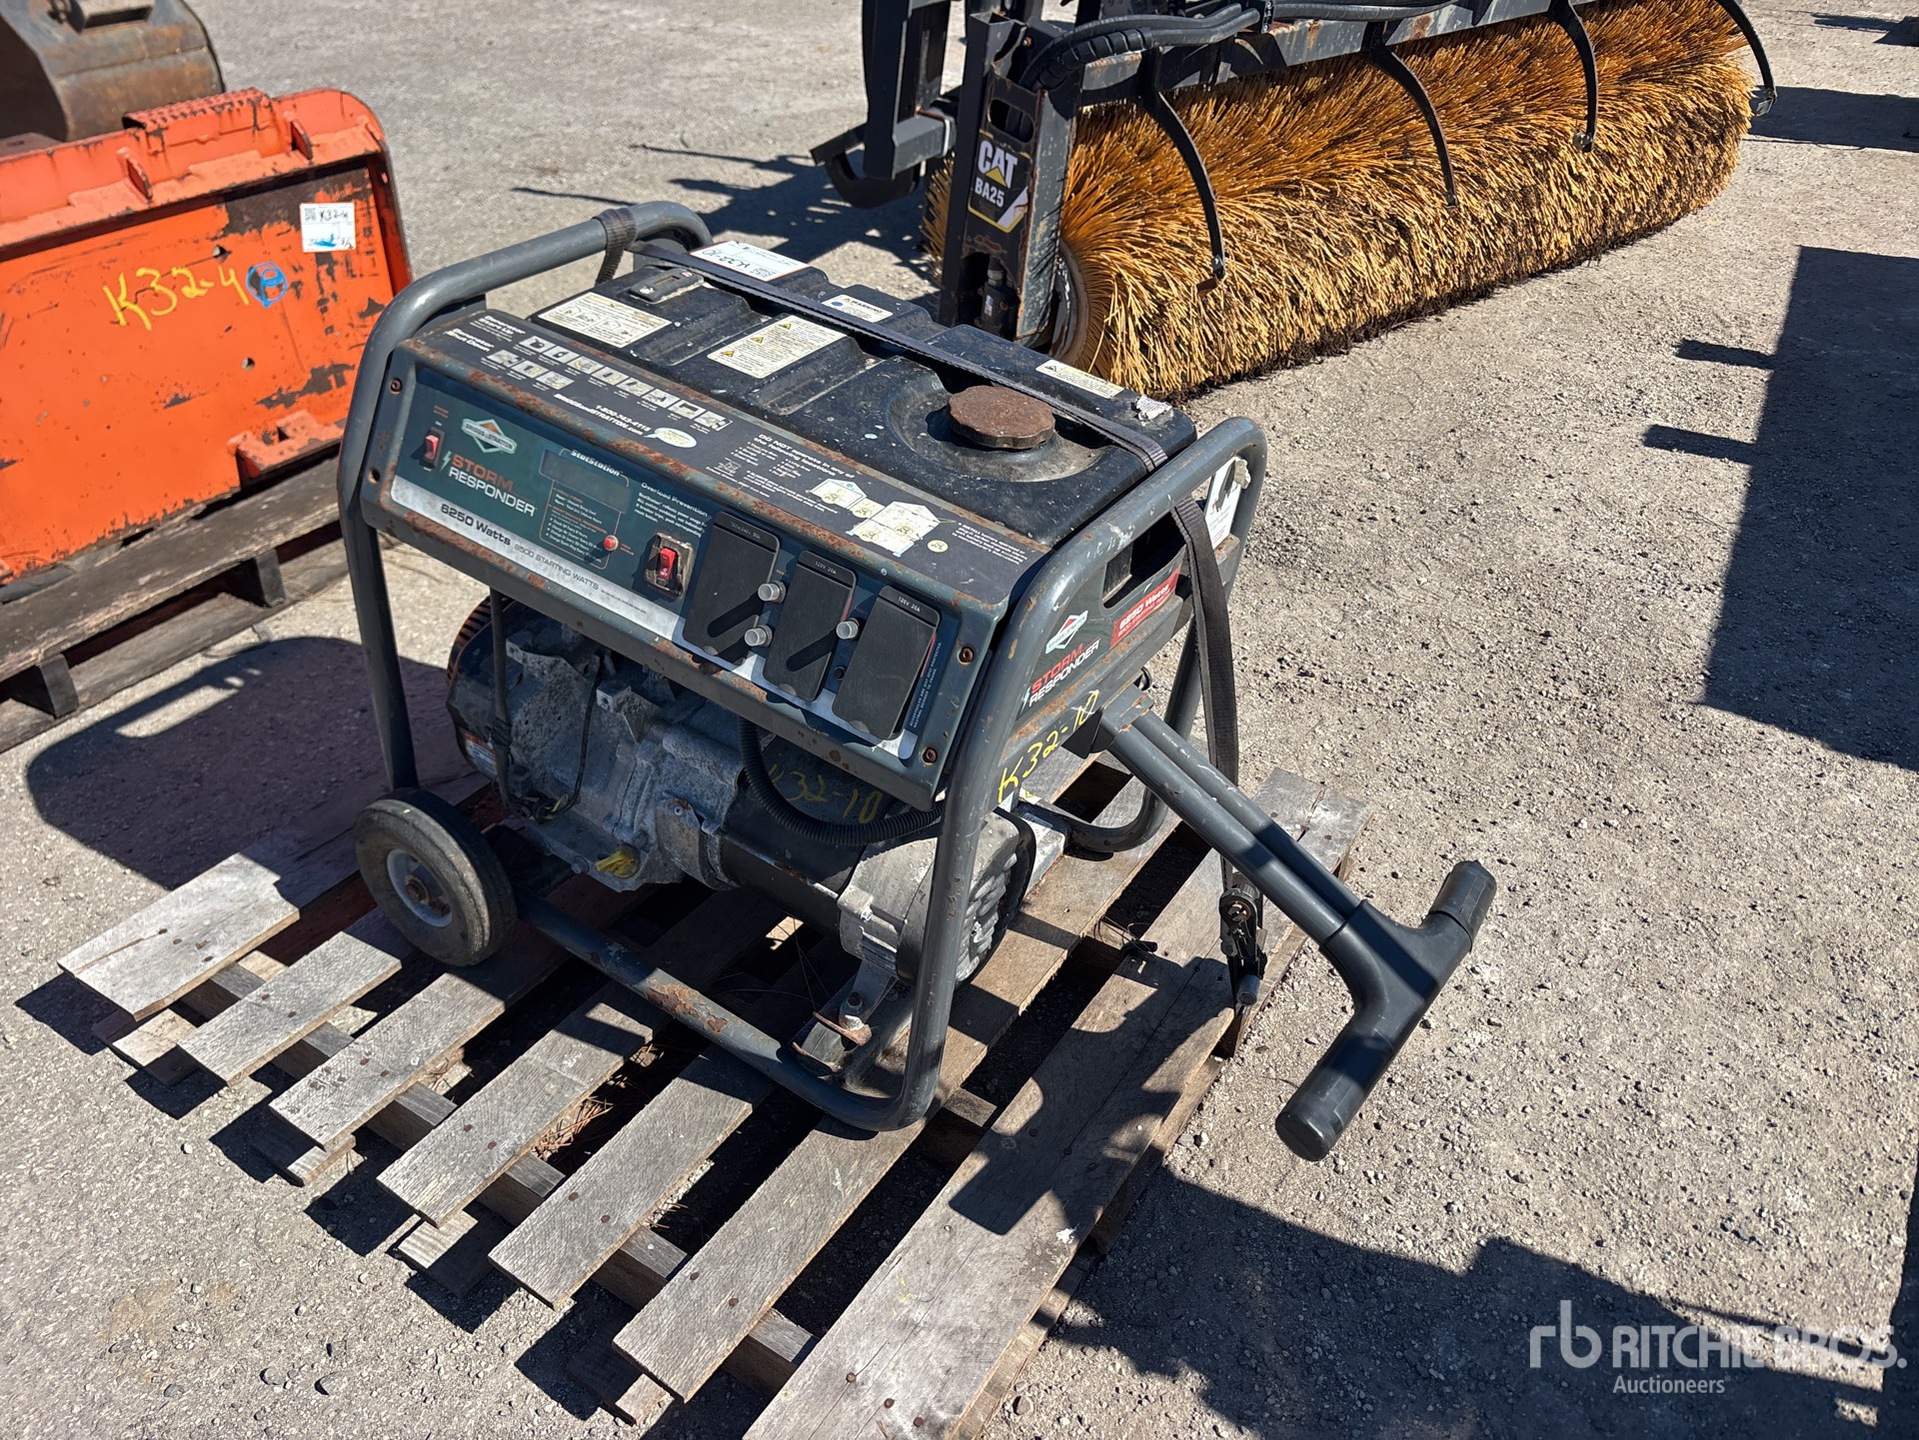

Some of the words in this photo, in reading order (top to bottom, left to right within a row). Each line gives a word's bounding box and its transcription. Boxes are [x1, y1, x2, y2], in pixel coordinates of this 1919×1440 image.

[978, 140, 1018, 188] CAT
[975, 177, 1005, 207] BA25
[103, 265, 250, 331] K32-4
[772, 440, 792, 450] NOT
[448, 466, 535, 517] RESPONDER
[450, 454, 515, 492] STORM
[641, 481, 671, 499] Overload
[671, 495, 708, 516] Prevention
[441, 503, 474, 527] 6250
[475, 521, 513, 547] Watts
[534, 552, 572, 581] STARTING
[572, 571, 600, 591] WATTS
[897, 596, 910, 606] 120V
[910, 603, 921, 612] 20A
[1118, 602, 1145, 631] 6250
[1028, 638, 1101, 707] RESPONDER
[1031, 644, 1084, 692] STORM
[998, 690, 1099, 803] K32-10
